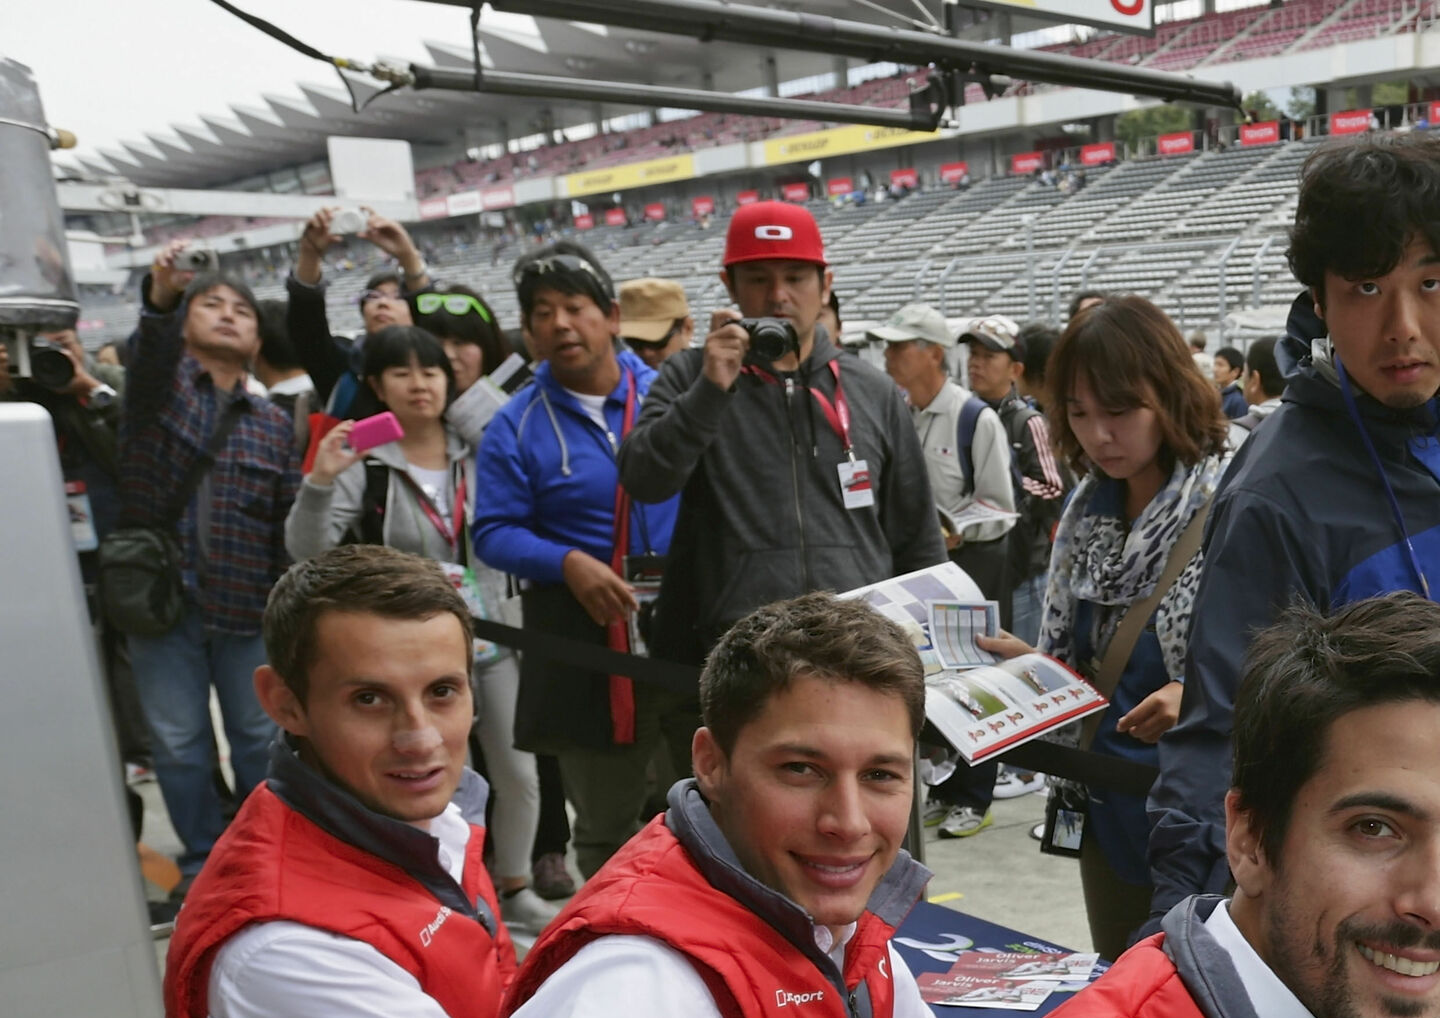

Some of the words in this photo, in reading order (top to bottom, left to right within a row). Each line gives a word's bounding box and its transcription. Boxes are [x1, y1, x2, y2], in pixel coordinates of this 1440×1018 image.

[1243, 127, 1275, 140] TOYOTA
[976, 957, 1017, 965] Jarvis
[931, 979, 973, 988] Jarvis
[954, 975, 1001, 985] Oliver
